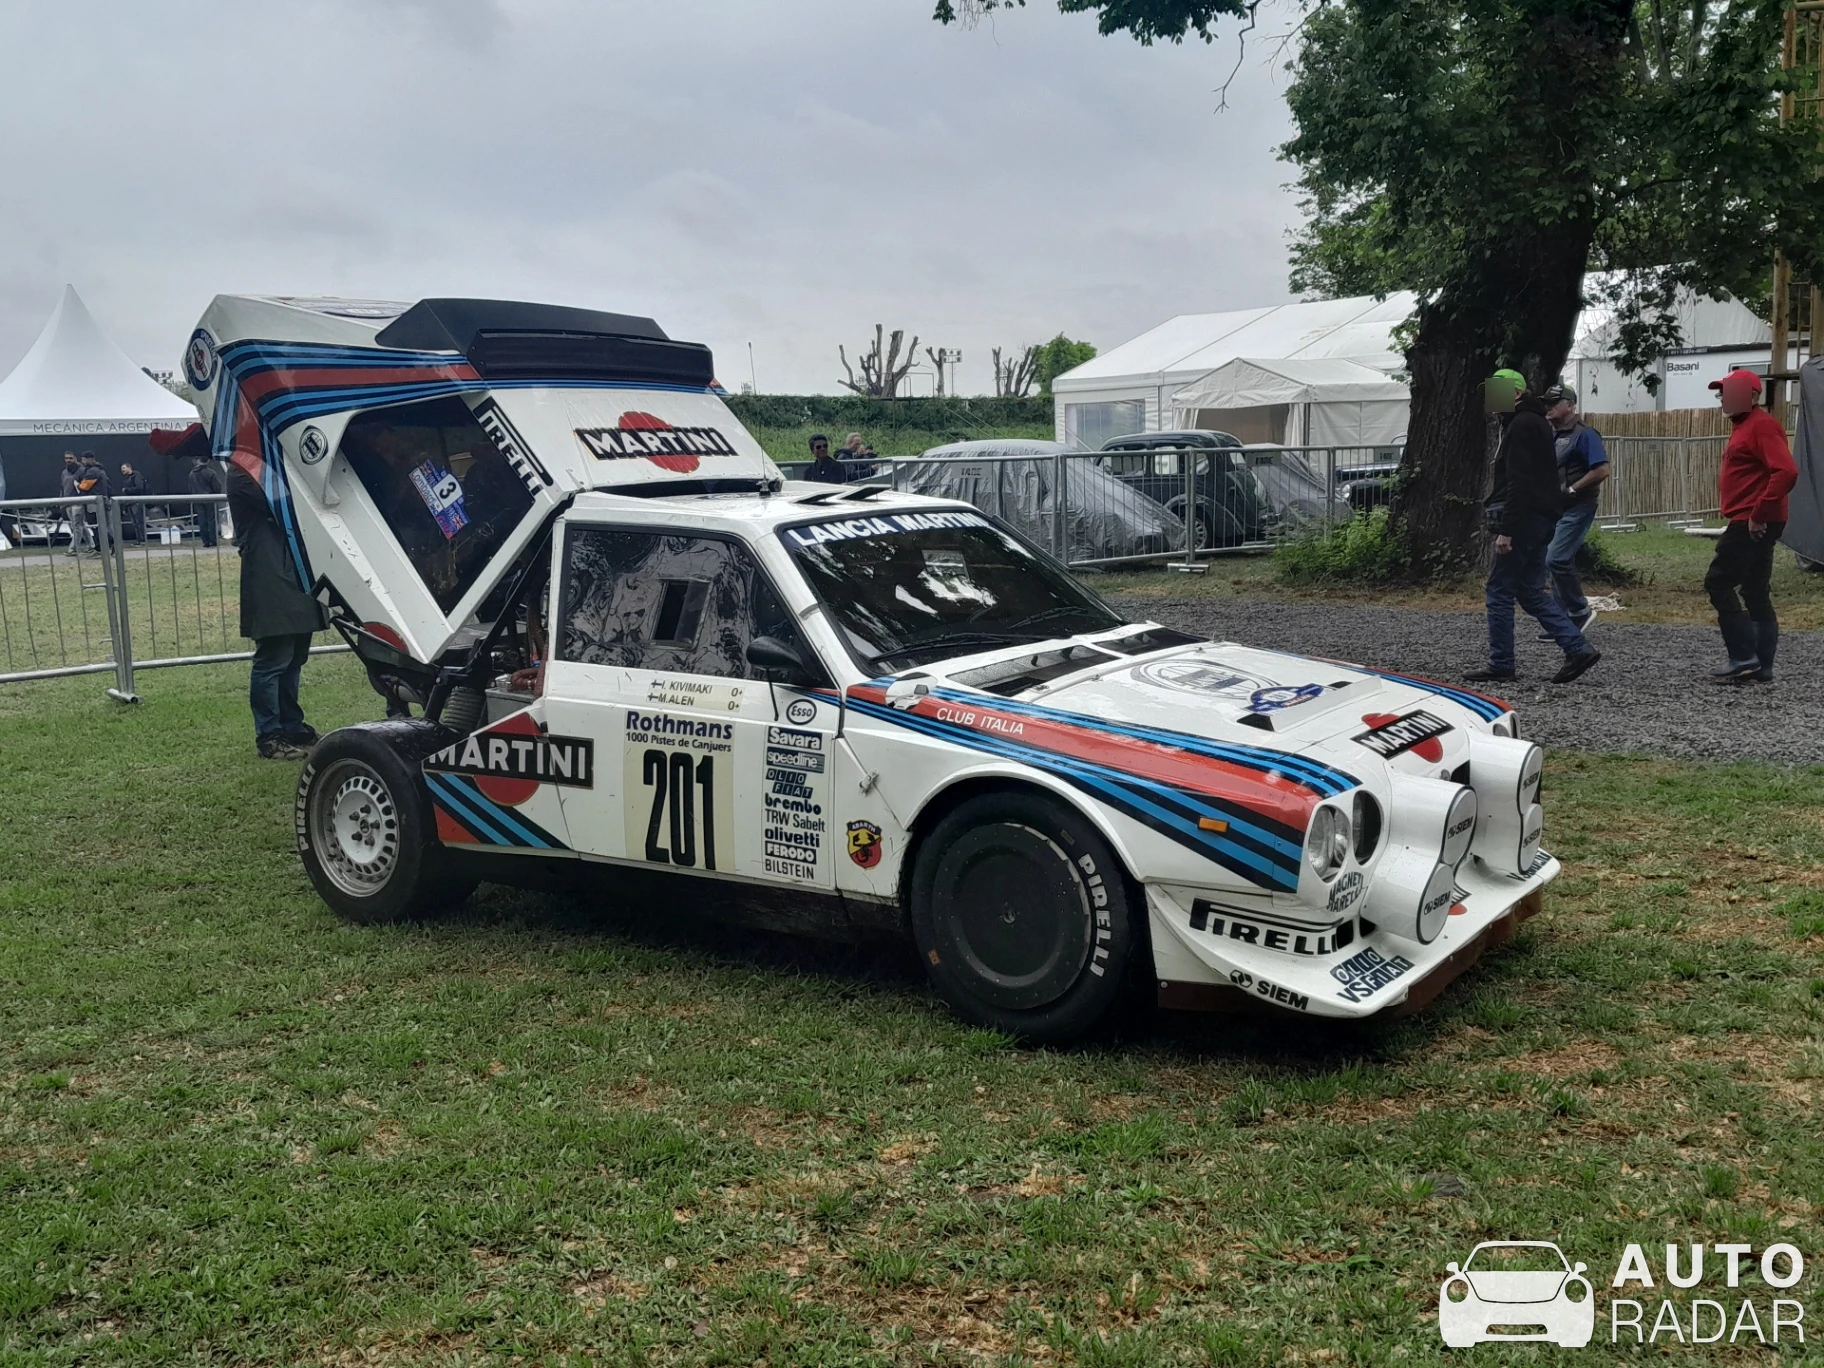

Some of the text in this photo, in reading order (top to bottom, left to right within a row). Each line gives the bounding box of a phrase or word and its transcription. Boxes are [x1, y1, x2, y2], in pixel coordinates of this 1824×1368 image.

[1667, 361, 1700, 372] Basani
[34, 422, 105, 433] MECÁNICA
[473, 396, 554, 496] PIRELLI
[585, 430, 733, 458] MARTINI
[411, 468, 437, 504] Lombard
[438, 481, 457, 499] 3
[789, 518, 894, 546] LANCIA
[669, 681, 713, 694] KIVIMAKI
[658, 693, 695, 706] M.ALEN
[626, 711, 733, 740] Rothmans
[936, 707, 1024, 734] CLUB ITALIA
[626, 732, 732, 753] 1000 Pistes de Canjuers
[769, 727, 821, 749] Savara
[1361, 712, 1447, 754] MARTINI
[429, 737, 586, 780] MARTINI
[767, 751, 818, 768] speedline
[767, 769, 805, 784] OLIO
[774, 783, 812, 797] FIAT
[296, 763, 316, 850] PIRELLI
[643, 749, 716, 870] 201
[765, 793, 822, 815] brembo
[765, 808, 826, 833] TRW Sabelt
[852, 821, 876, 833] ABARTH
[1457, 816, 1474, 835] SIEM
[764, 826, 820, 848] olivetti
[766, 842, 815, 862] FERODO
[765, 858, 814, 880] BILSTEIN
[1078, 853, 1112, 977] PIRELLI
[1189, 898, 1345, 955] PIRELLI
[1335, 950, 1382, 981] OLIO
[1255, 981, 1309, 1010] SIEM
